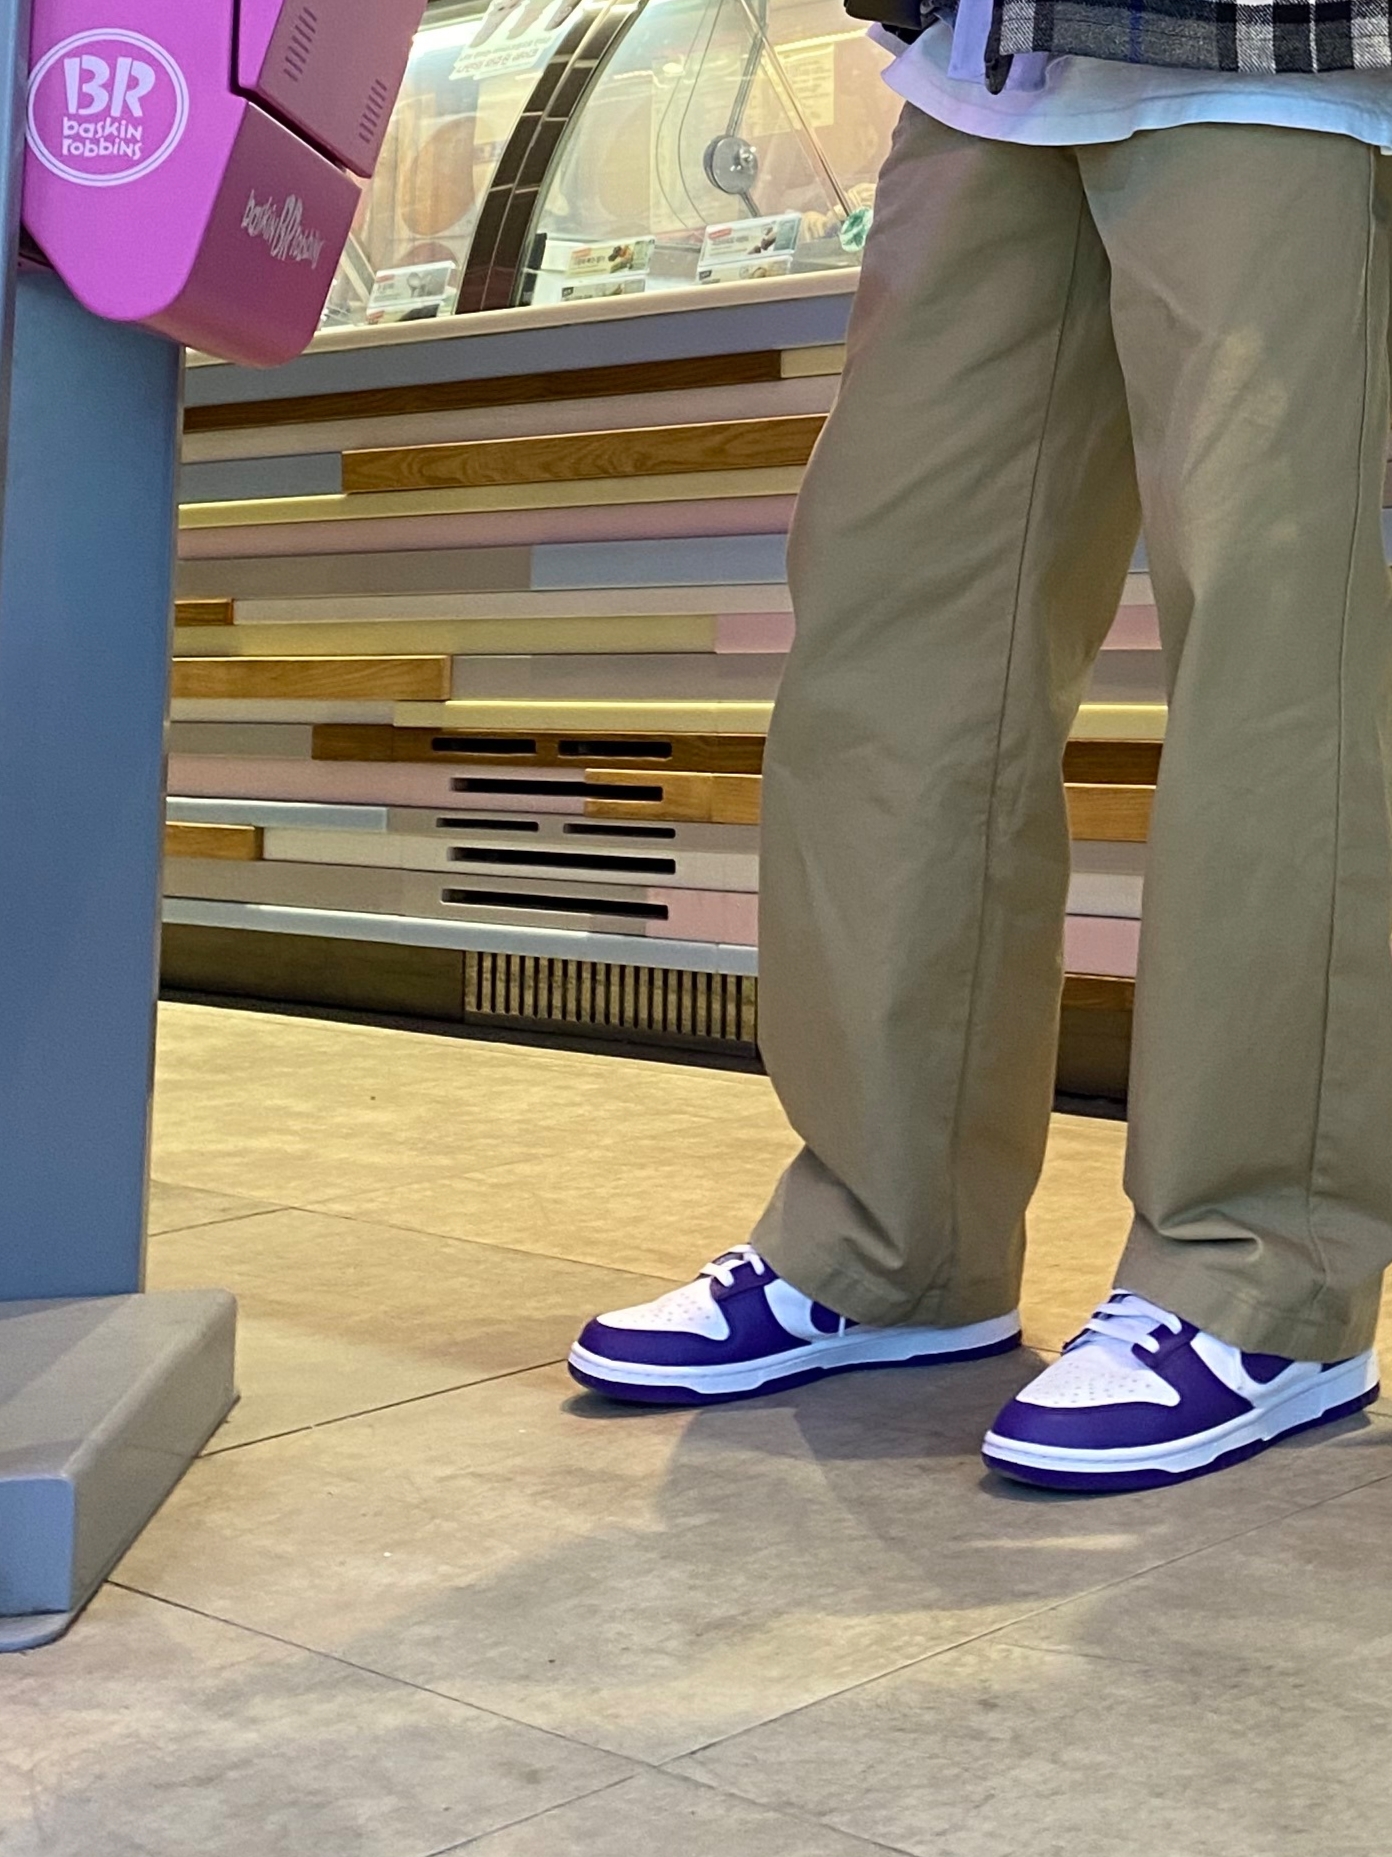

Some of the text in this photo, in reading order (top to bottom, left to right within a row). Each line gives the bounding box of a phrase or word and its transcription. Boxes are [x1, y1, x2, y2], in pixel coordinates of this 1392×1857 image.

[63, 54, 156, 118] BR
[63, 116, 143, 142] baskin
[62, 137, 143, 161] robbins
